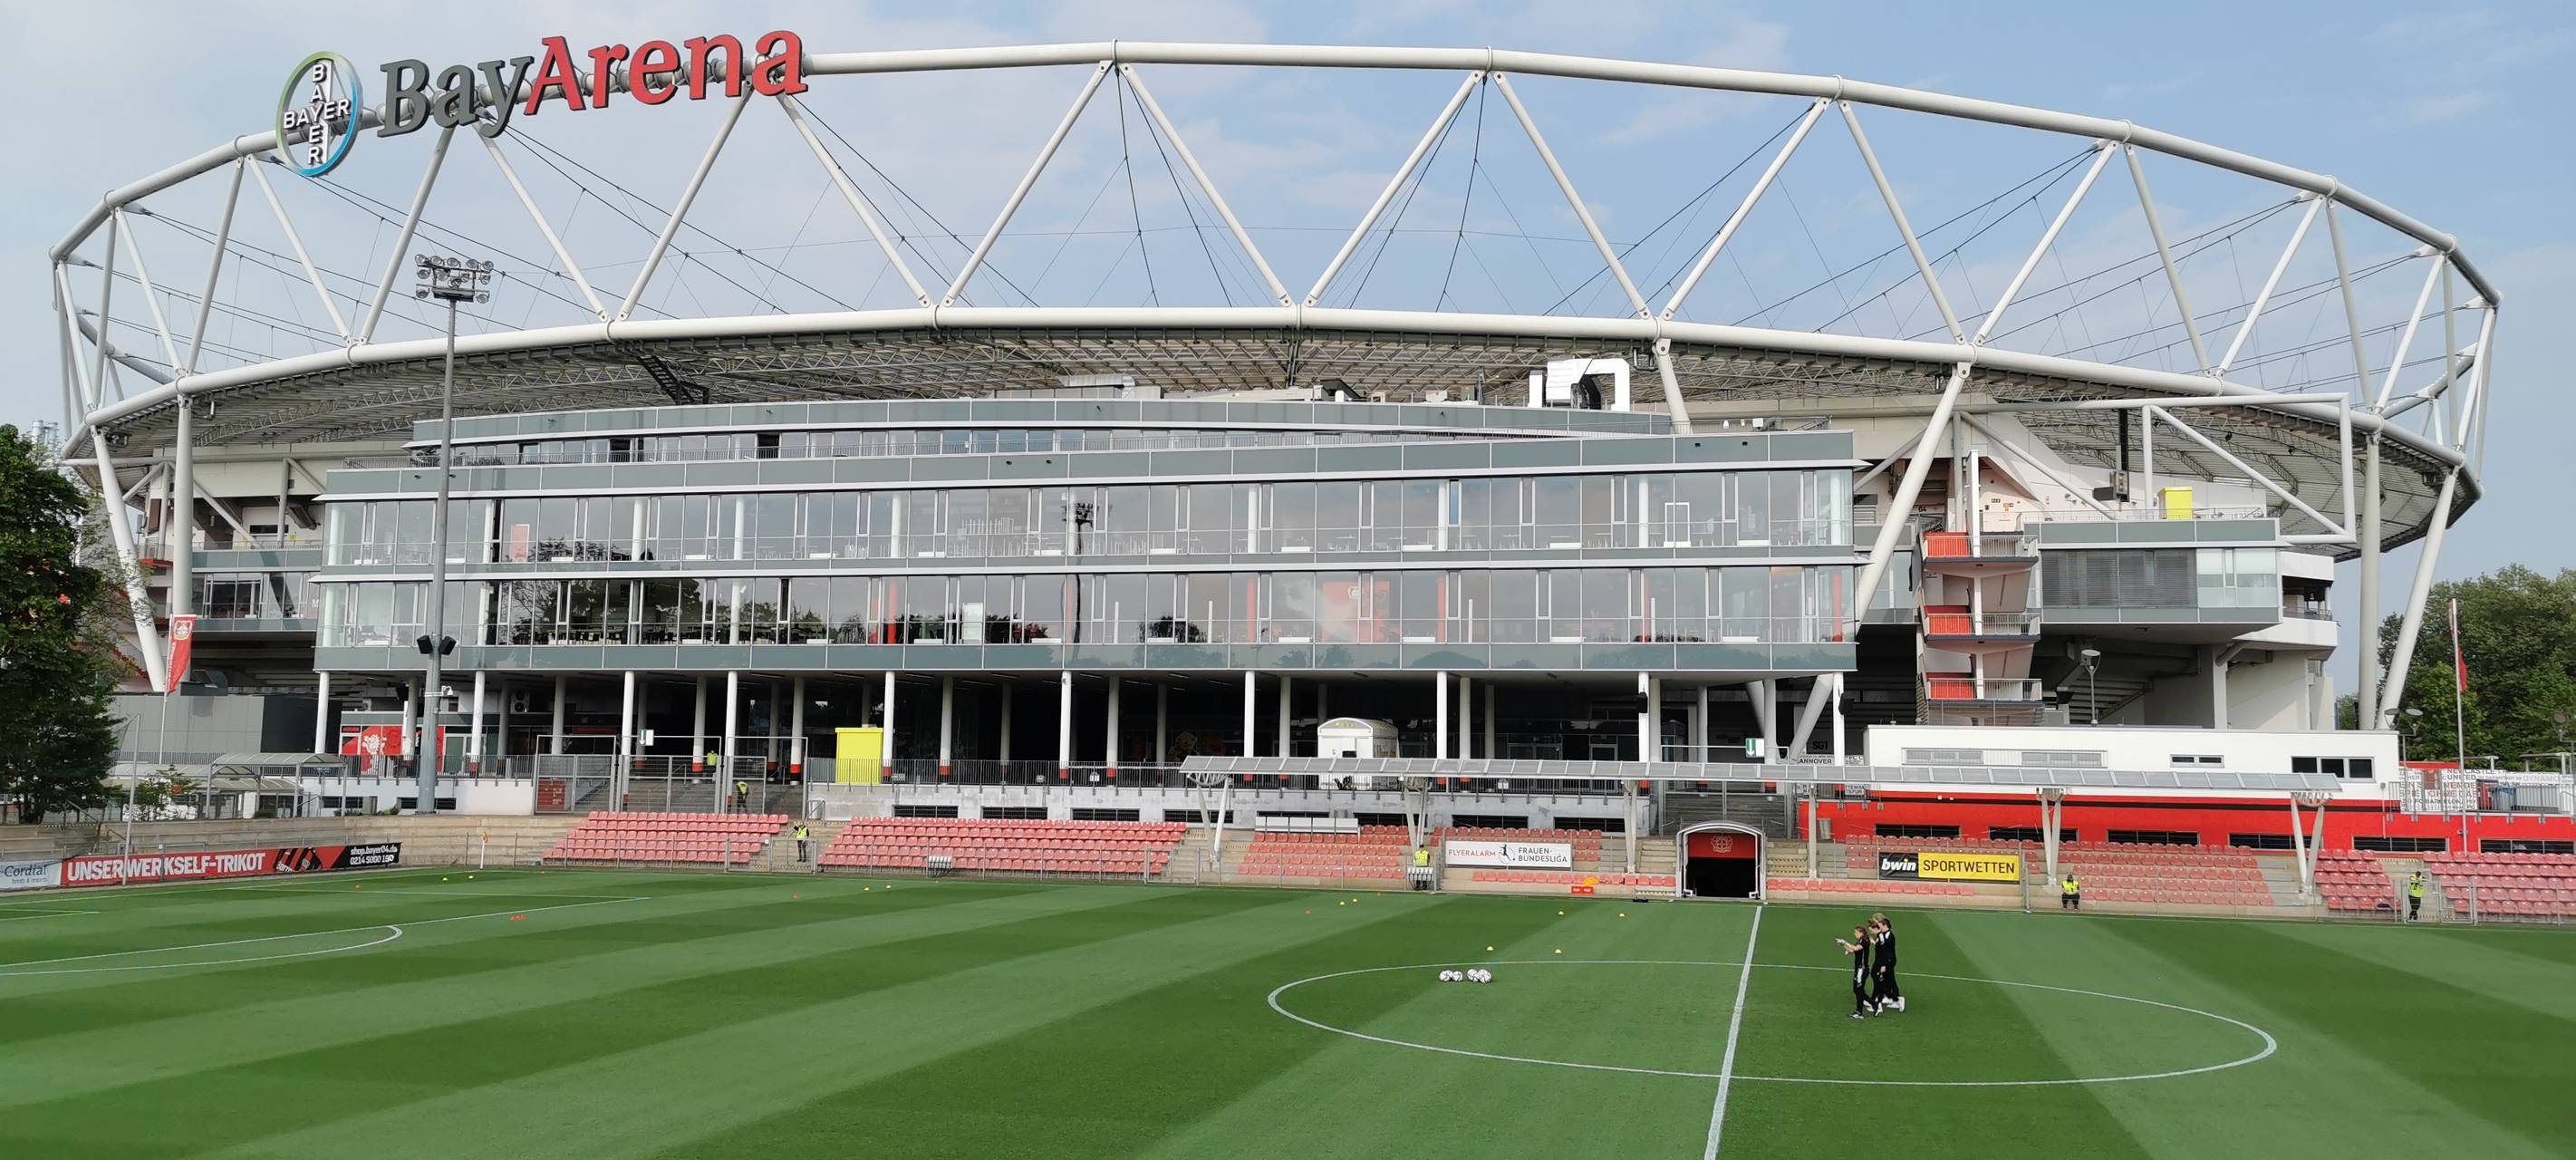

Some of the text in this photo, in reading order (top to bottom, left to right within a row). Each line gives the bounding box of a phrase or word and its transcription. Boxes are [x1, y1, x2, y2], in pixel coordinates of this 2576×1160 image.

[377, 29, 809, 140] BayArena
[283, 98, 352, 130] BAYER
[307, 63, 327, 166] BAYER
[1448, 848, 1496, 857] FLYERALARM
[1518, 854, 1568, 863] BUNDESLIGA
[350, 856, 365, 865] 0214
[366, 855, 381, 864] 5000
[1881, 858, 1917, 872] bwin
[1923, 859, 2015, 874] SPORTWETTEN
